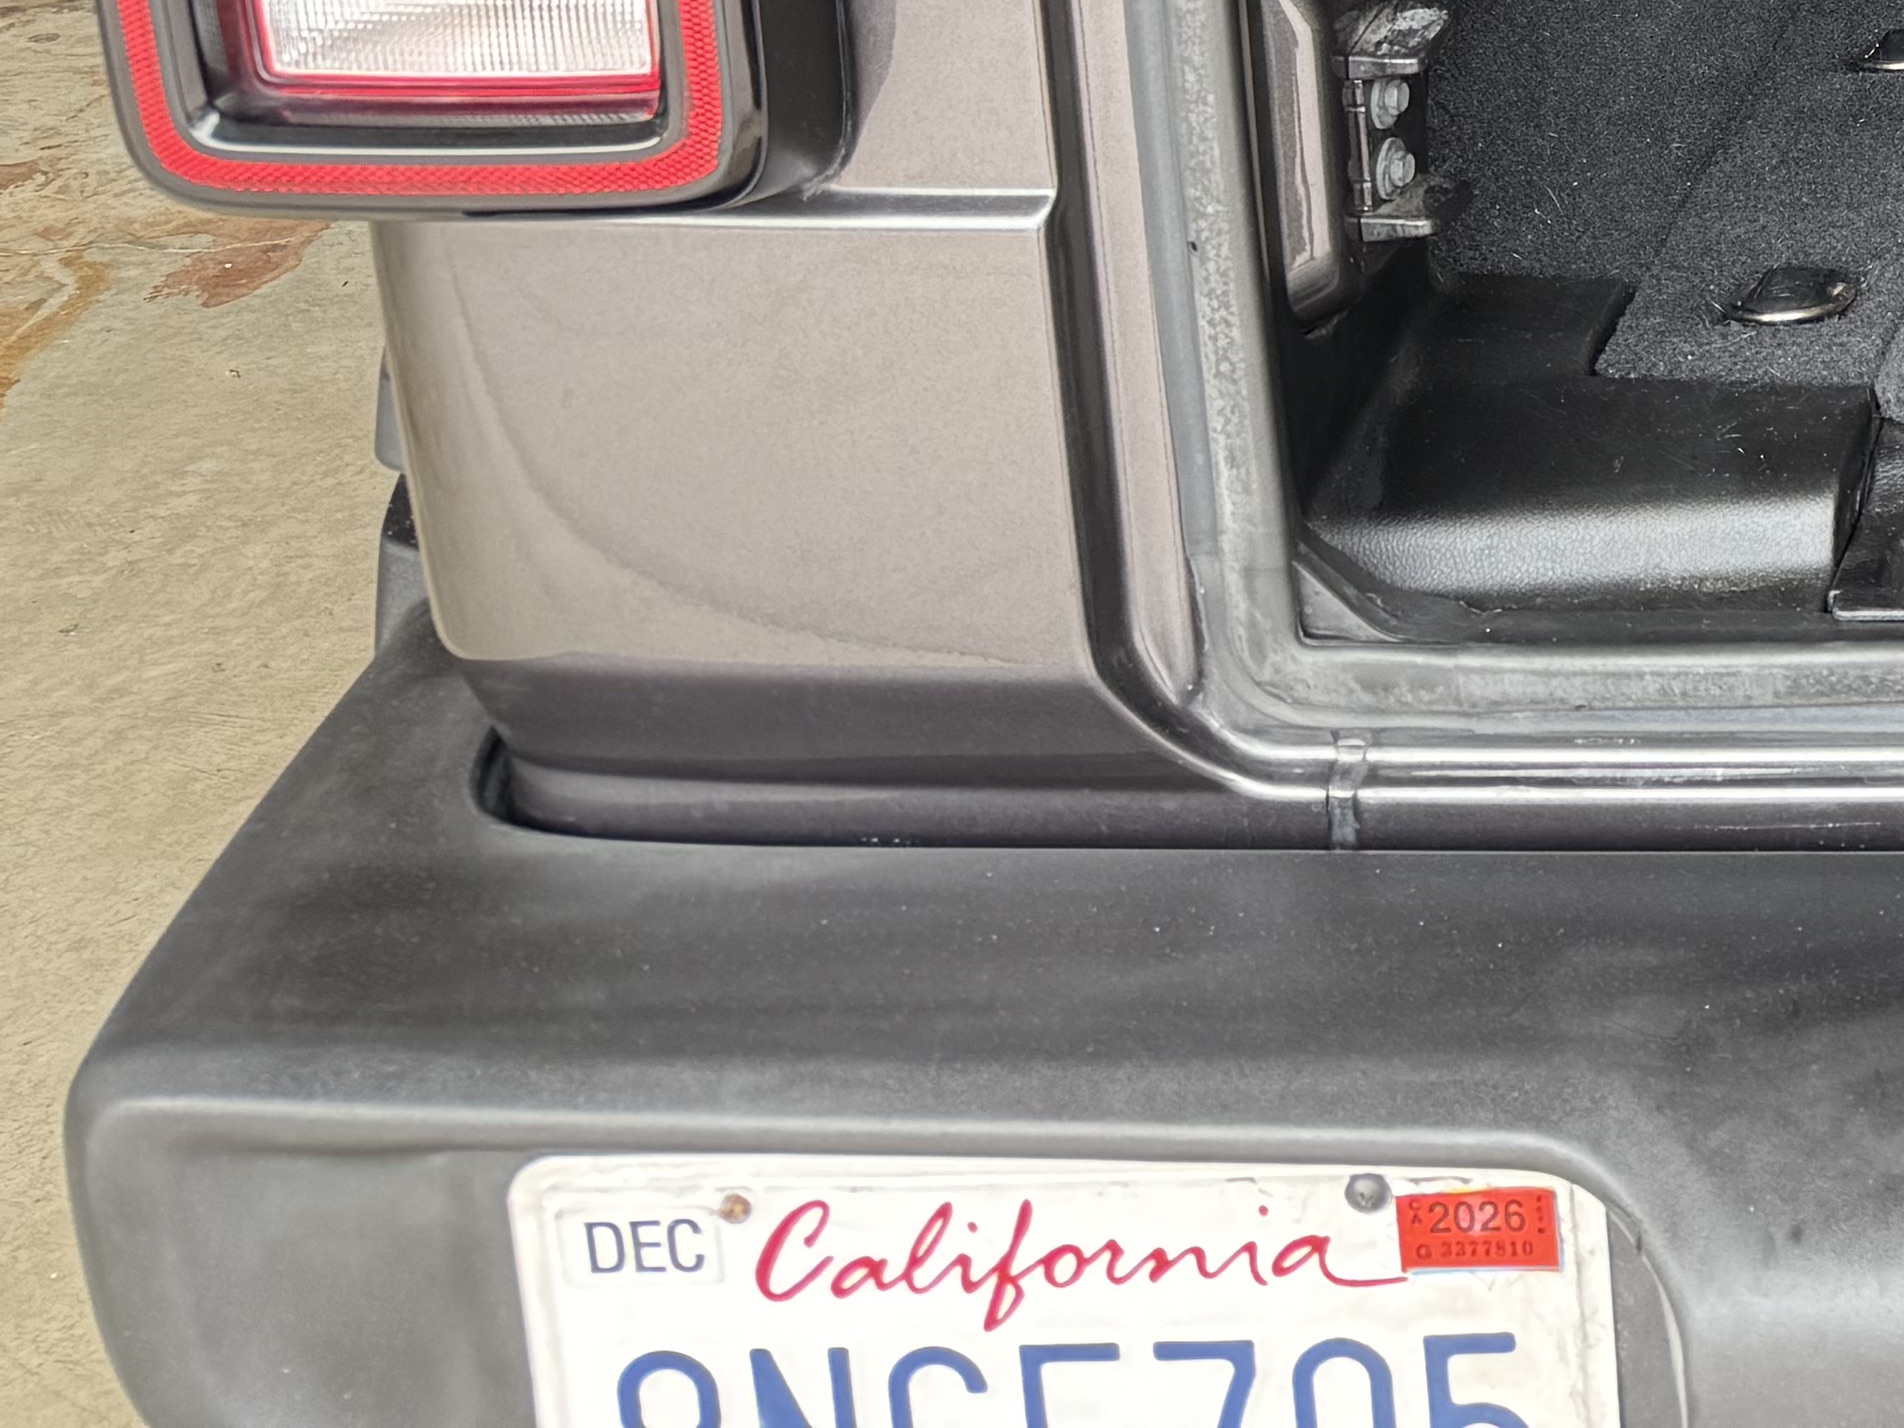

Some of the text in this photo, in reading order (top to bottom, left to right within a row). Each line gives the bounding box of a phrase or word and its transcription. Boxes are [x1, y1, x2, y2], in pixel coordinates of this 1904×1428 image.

[1428, 1199, 1527, 1234] 2026
[583, 1218, 706, 1274] DEC
[755, 1198, 1409, 1332] California
